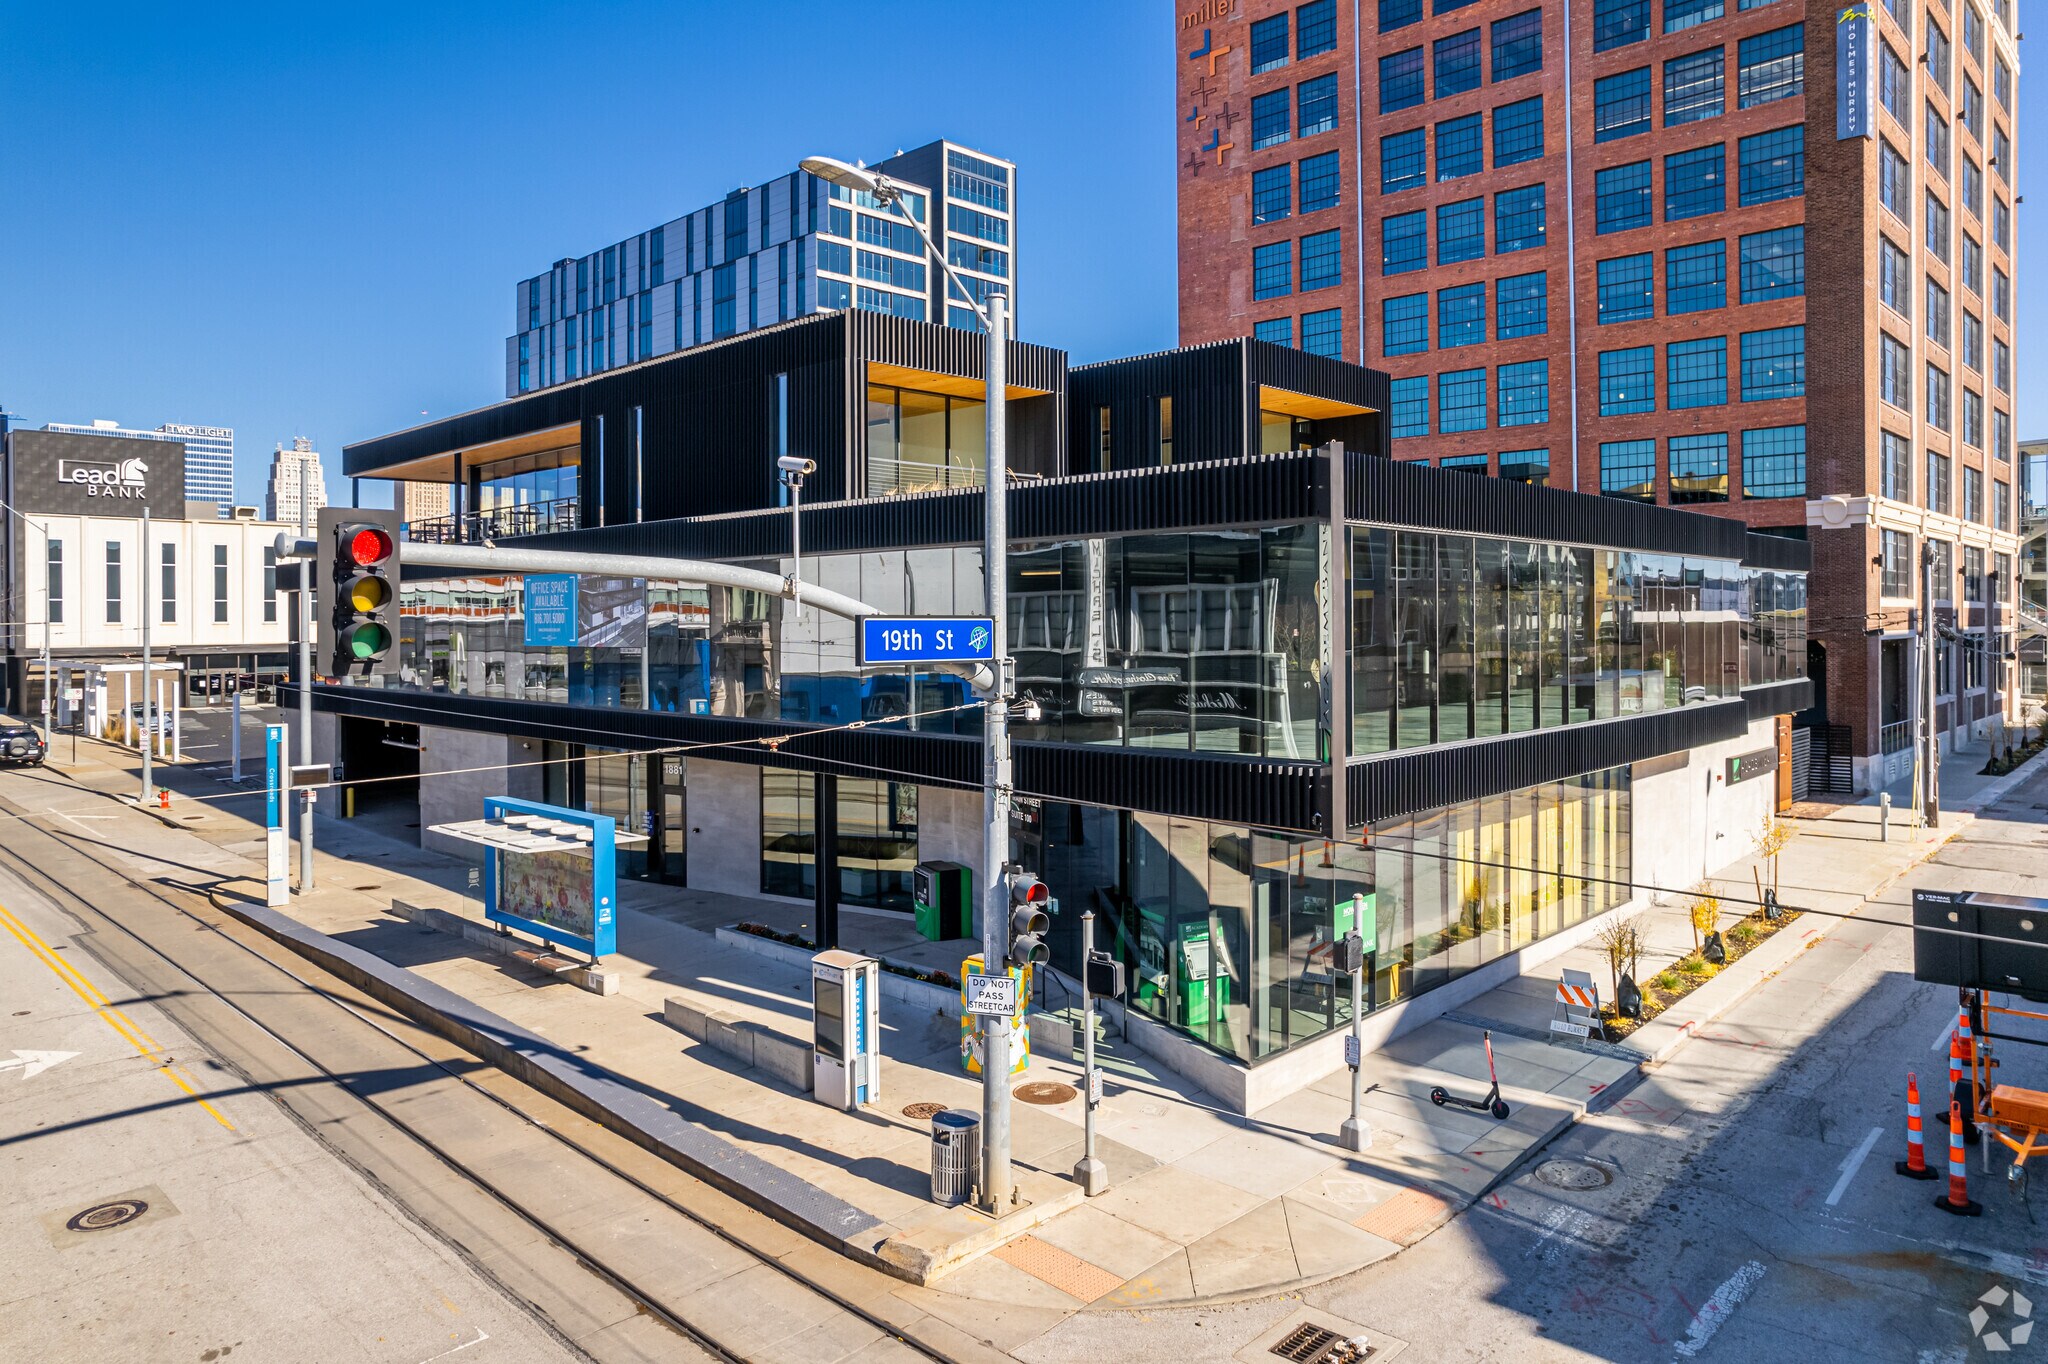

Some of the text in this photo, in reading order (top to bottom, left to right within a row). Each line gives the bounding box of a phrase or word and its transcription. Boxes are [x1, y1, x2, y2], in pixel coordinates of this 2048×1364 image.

[1182, 0, 1235, 30] miller
[1848, 23, 1856, 132] HOLMES MURPHY
[170, 424, 231, 438] TWO LIGHT
[58, 459, 121, 485] Lead
[87, 485, 146, 499] BANK
[531, 580, 569, 595] OFFICE SPACE
[534, 595, 564, 607] AVAILABLE
[881, 628, 954, 651] 19th St
[664, 765, 683, 774] 1881
[1011, 809, 1024, 821] SUITE
[973, 979, 1009, 989] DO NOT
[978, 991, 1004, 1001] PASS
[968, 1000, 1014, 1012] STREETCAR
